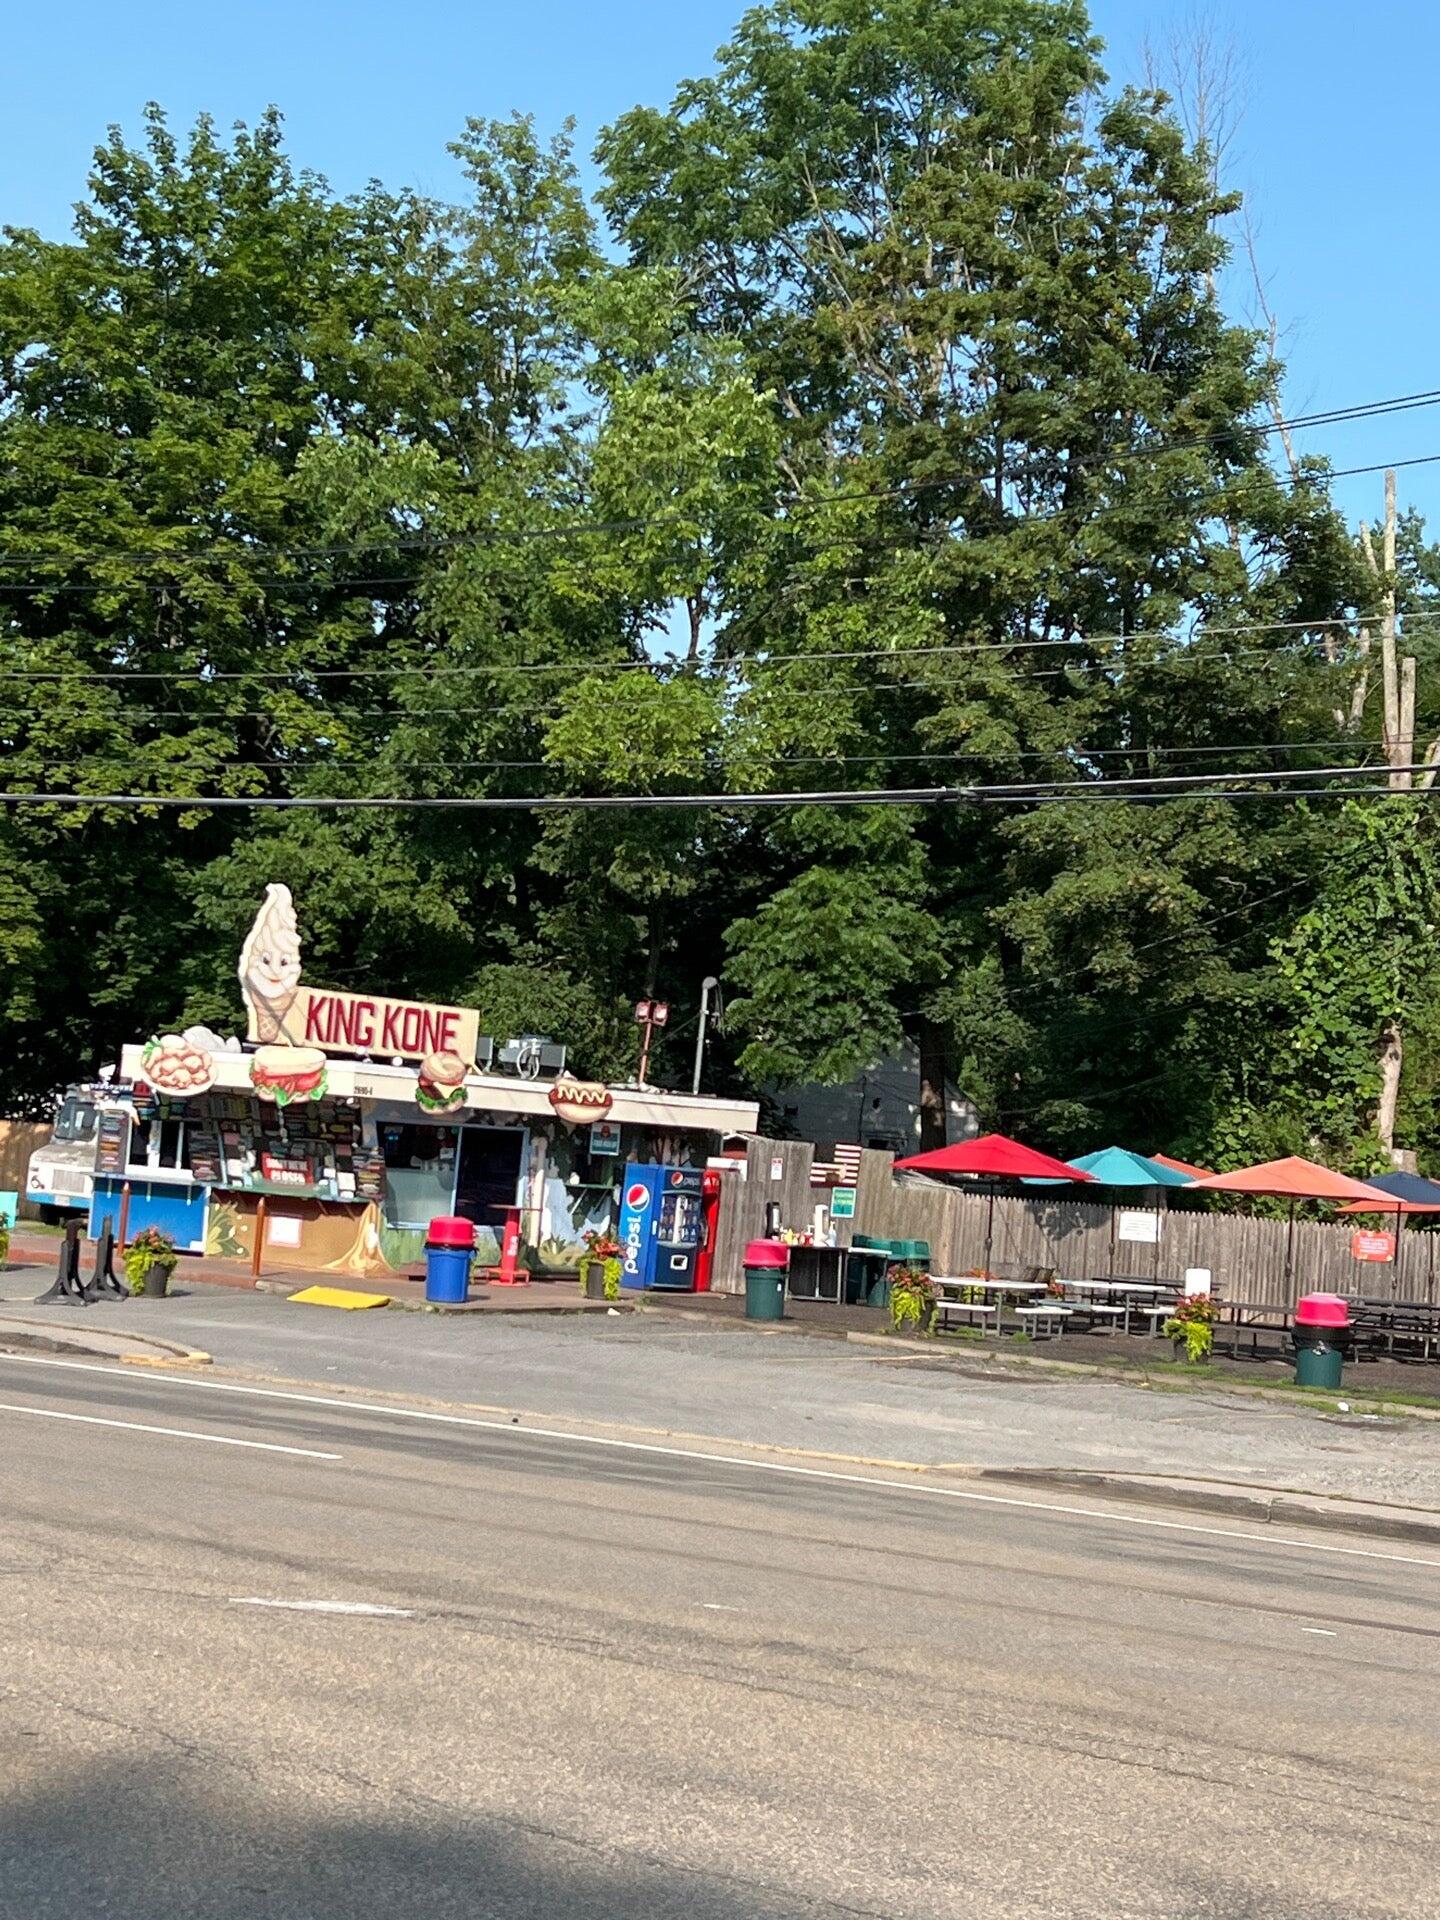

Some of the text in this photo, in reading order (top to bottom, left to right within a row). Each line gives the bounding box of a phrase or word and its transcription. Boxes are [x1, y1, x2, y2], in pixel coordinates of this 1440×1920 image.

[305, 994, 461, 1055] KING KONE
[624, 1215, 641, 1274] pepsi
